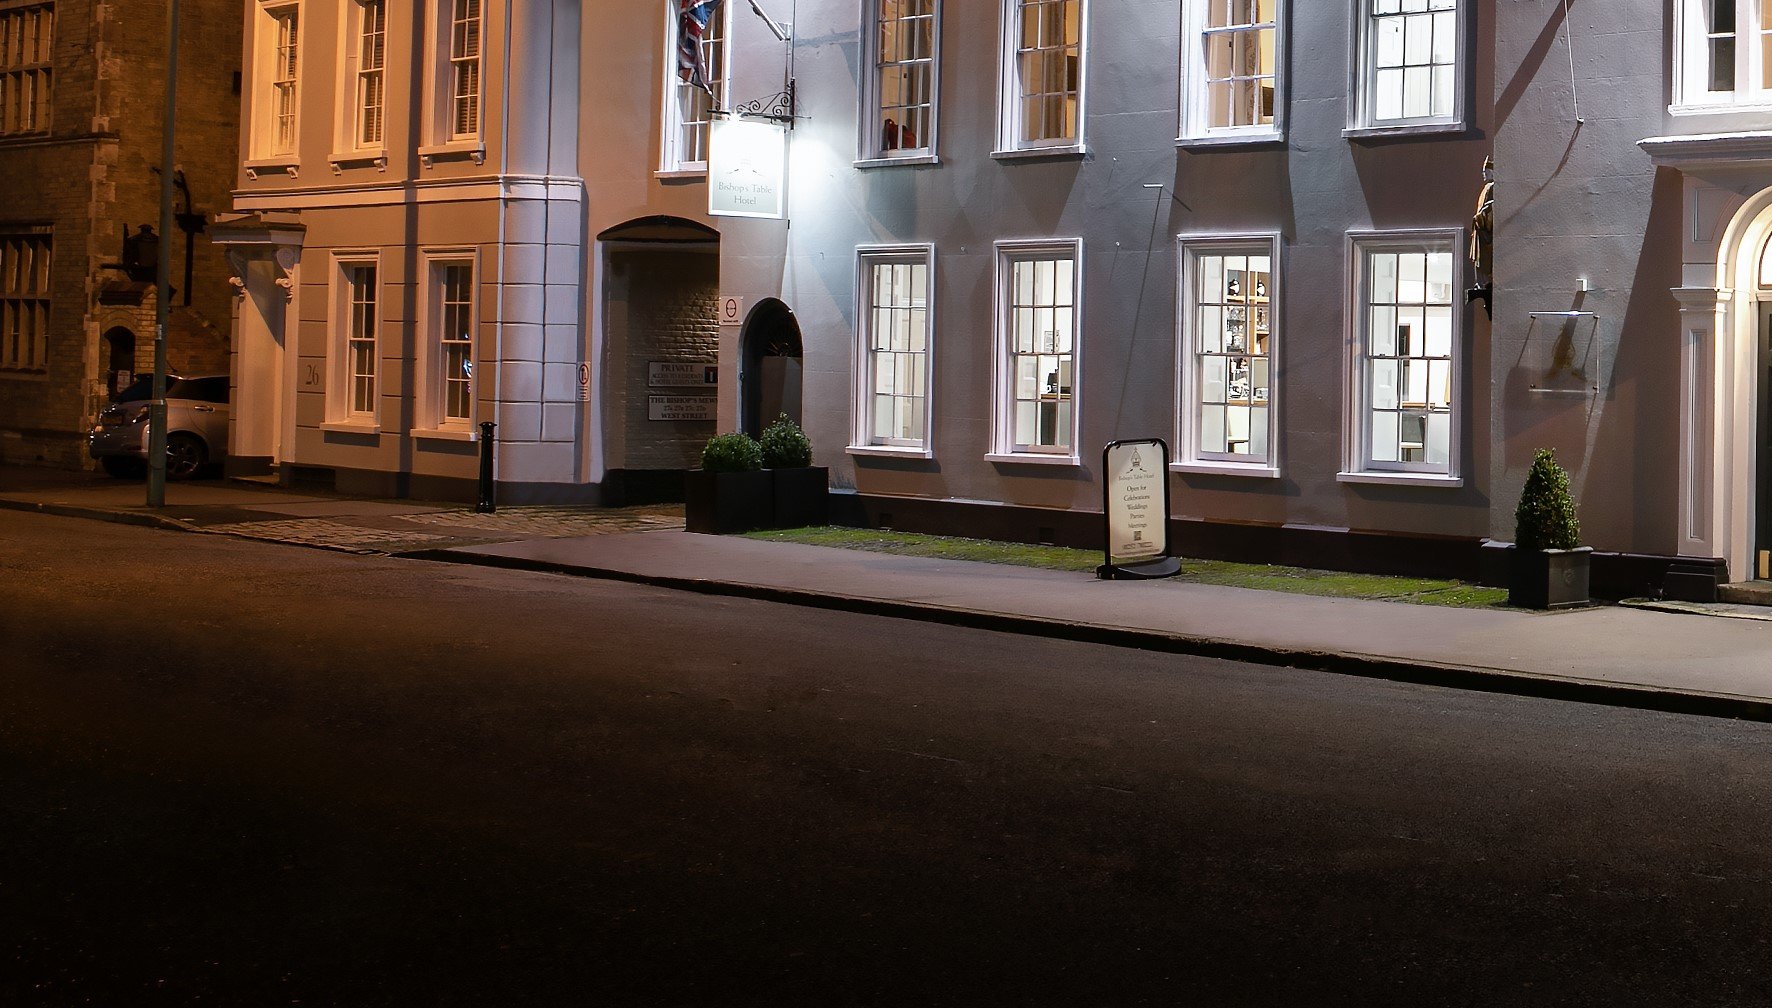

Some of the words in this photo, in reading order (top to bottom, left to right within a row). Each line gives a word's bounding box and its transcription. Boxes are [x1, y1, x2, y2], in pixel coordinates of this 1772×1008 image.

[752, 184, 772, 194] Table
[734, 195, 756, 205] Hotel
[661, 364, 694, 372] PRIVATE
[305, 365, 319, 385] 26
